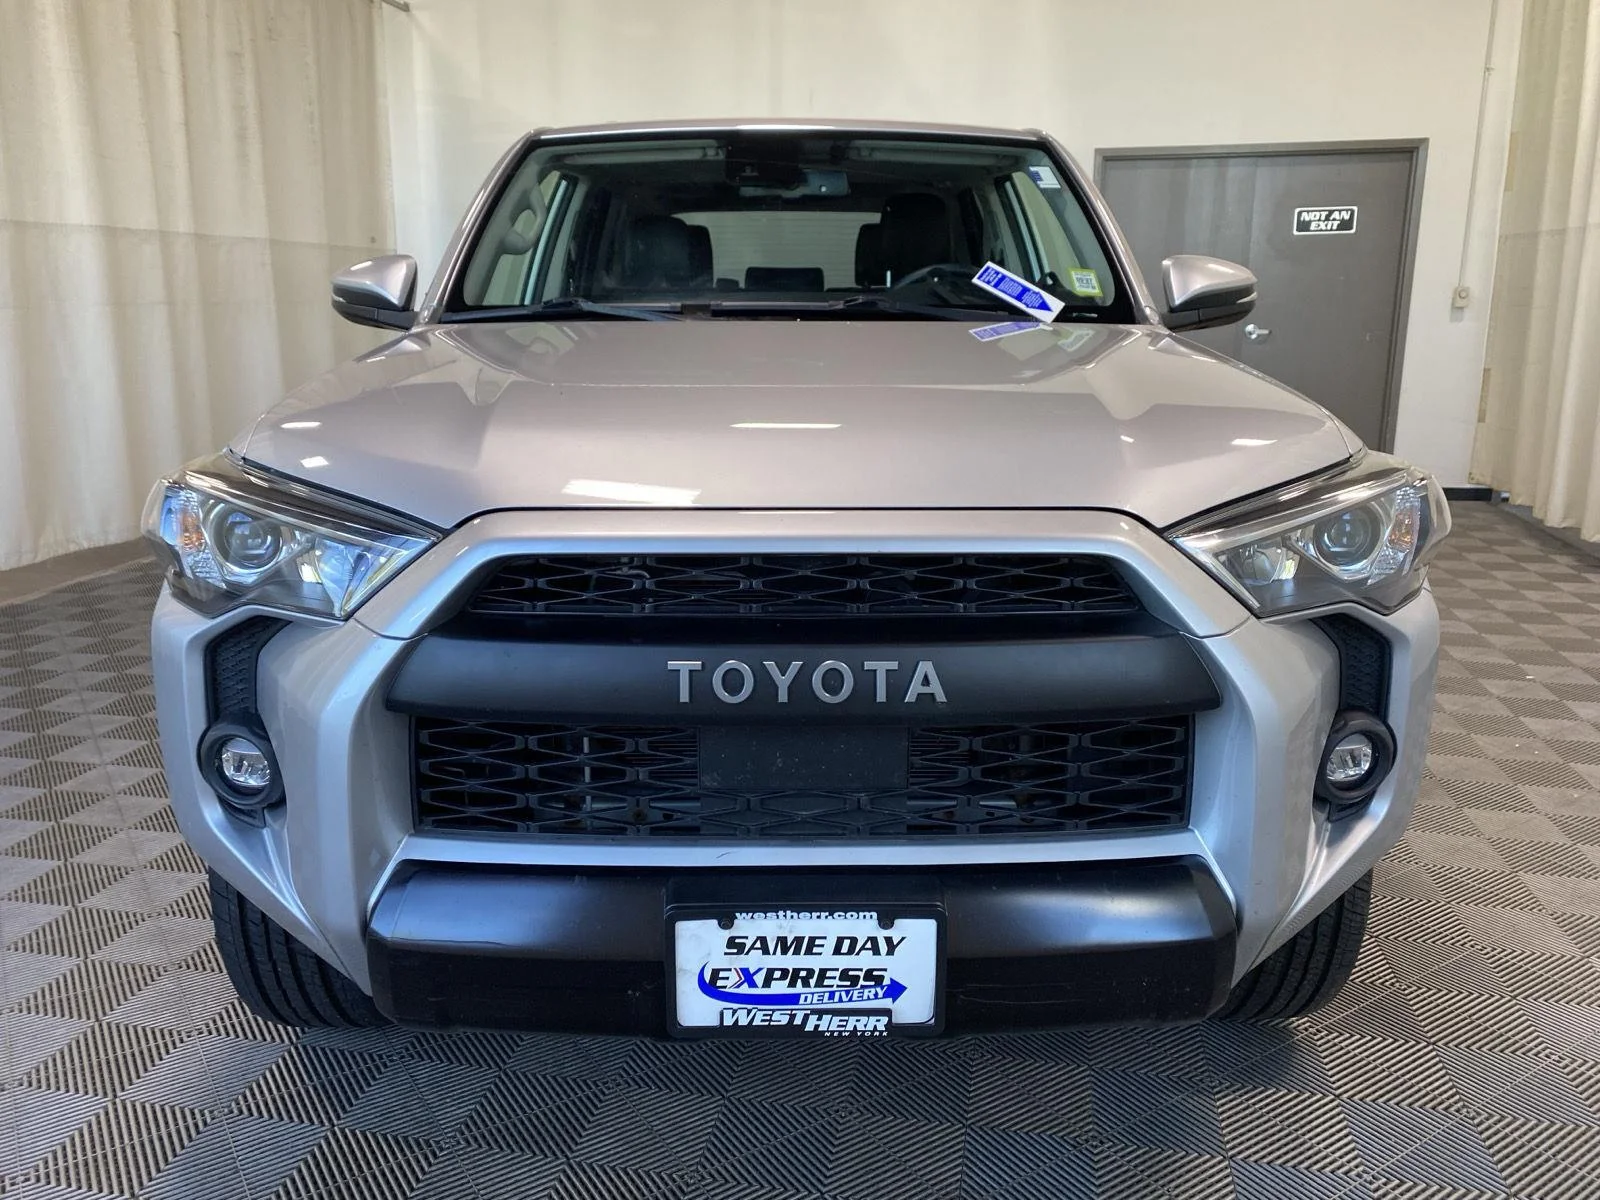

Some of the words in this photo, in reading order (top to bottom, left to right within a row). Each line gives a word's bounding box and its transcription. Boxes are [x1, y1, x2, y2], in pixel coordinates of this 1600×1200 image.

[1300, 211, 1328, 221] NOT
[1329, 210, 1351, 220] AN
[1309, 220, 1341, 230] EXIT
[667, 660, 948, 704] TOYOTA
[735, 910, 878, 921] westherr.com
[723, 936, 827, 956] SAME
[832, 936, 907, 956] DAY
[708, 967, 887, 989] EXPRESS
[798, 985, 888, 1005] DELIVERY
